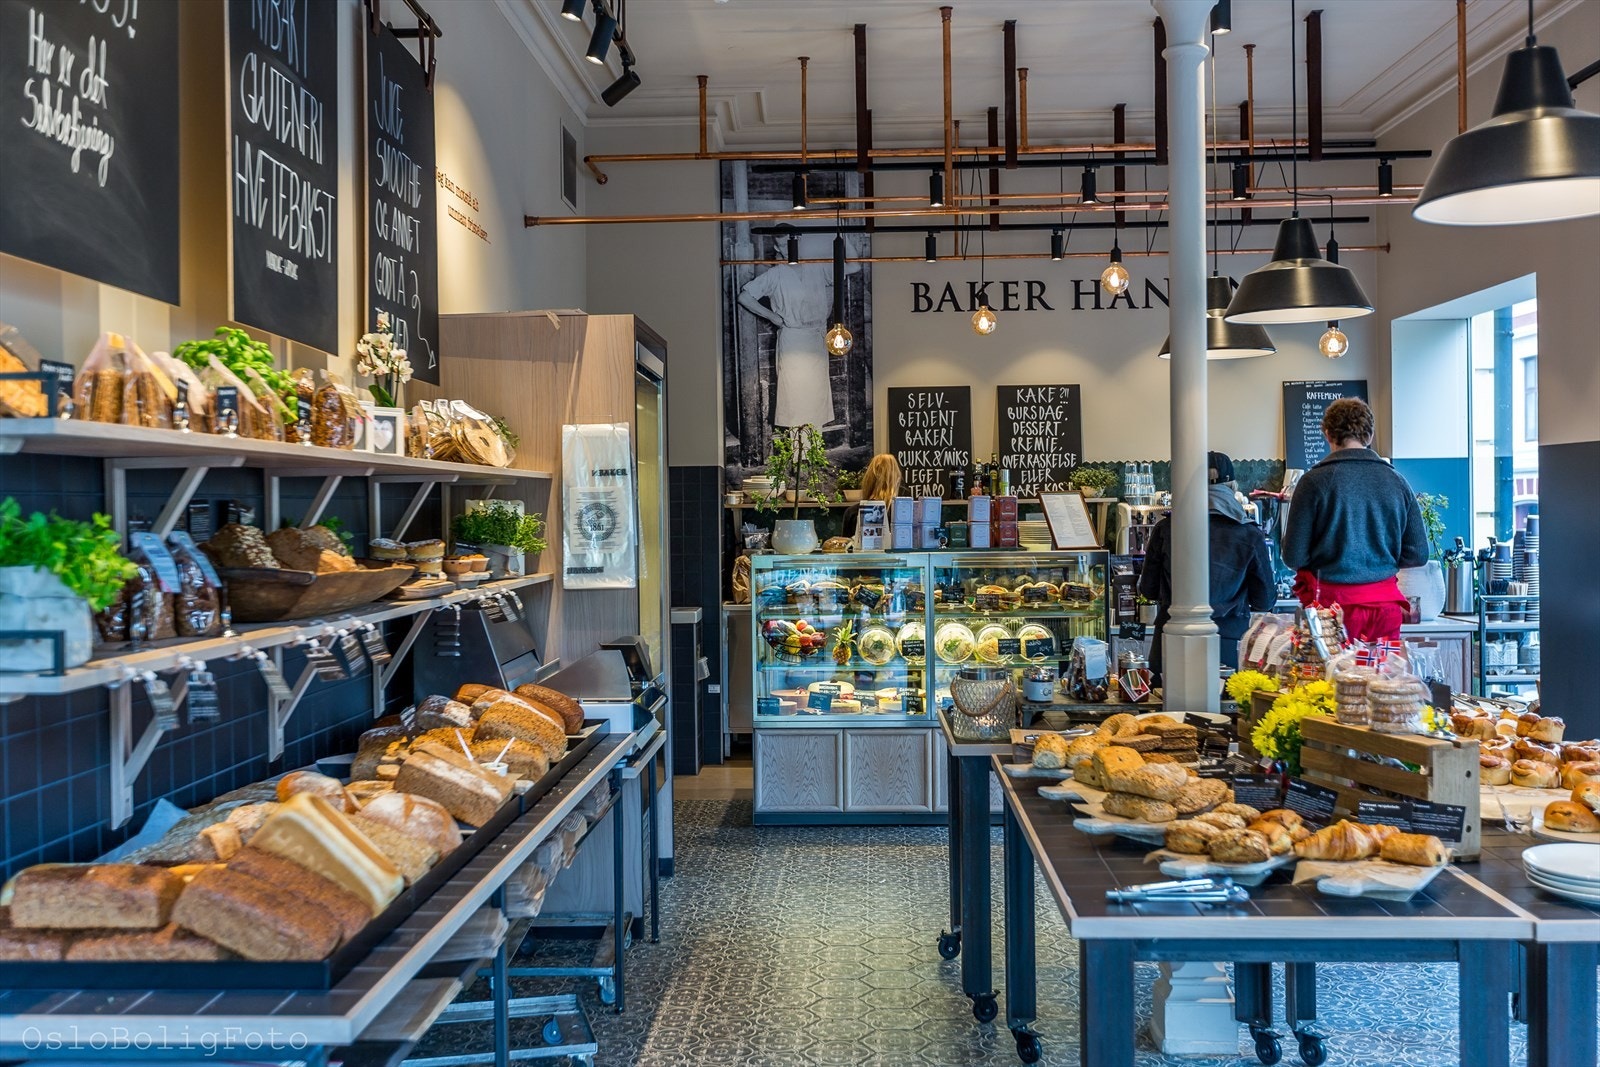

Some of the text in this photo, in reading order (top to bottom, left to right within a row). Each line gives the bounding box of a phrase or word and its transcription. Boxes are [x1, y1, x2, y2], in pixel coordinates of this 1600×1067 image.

[241, 52, 323, 165] GLUTENFRI
[235, 134, 335, 264] HVETEBAKST
[375, 198, 388, 240] OG
[910, 278, 1171, 313] BAKER HAN
[908, 392, 950, 409] SELV-
[1017, 387, 1056, 404] KAKE
[898, 409, 959, 428] BETJENT
[898, 450, 932, 467] PLUKK
[1002, 452, 1077, 469] OVERRASKELSE
[912, 468, 944, 484] EGET
[1021, 468, 1055, 484] ELLER
[909, 483, 945, 498] TEMPO
[1010, 483, 1040, 497] BARE
